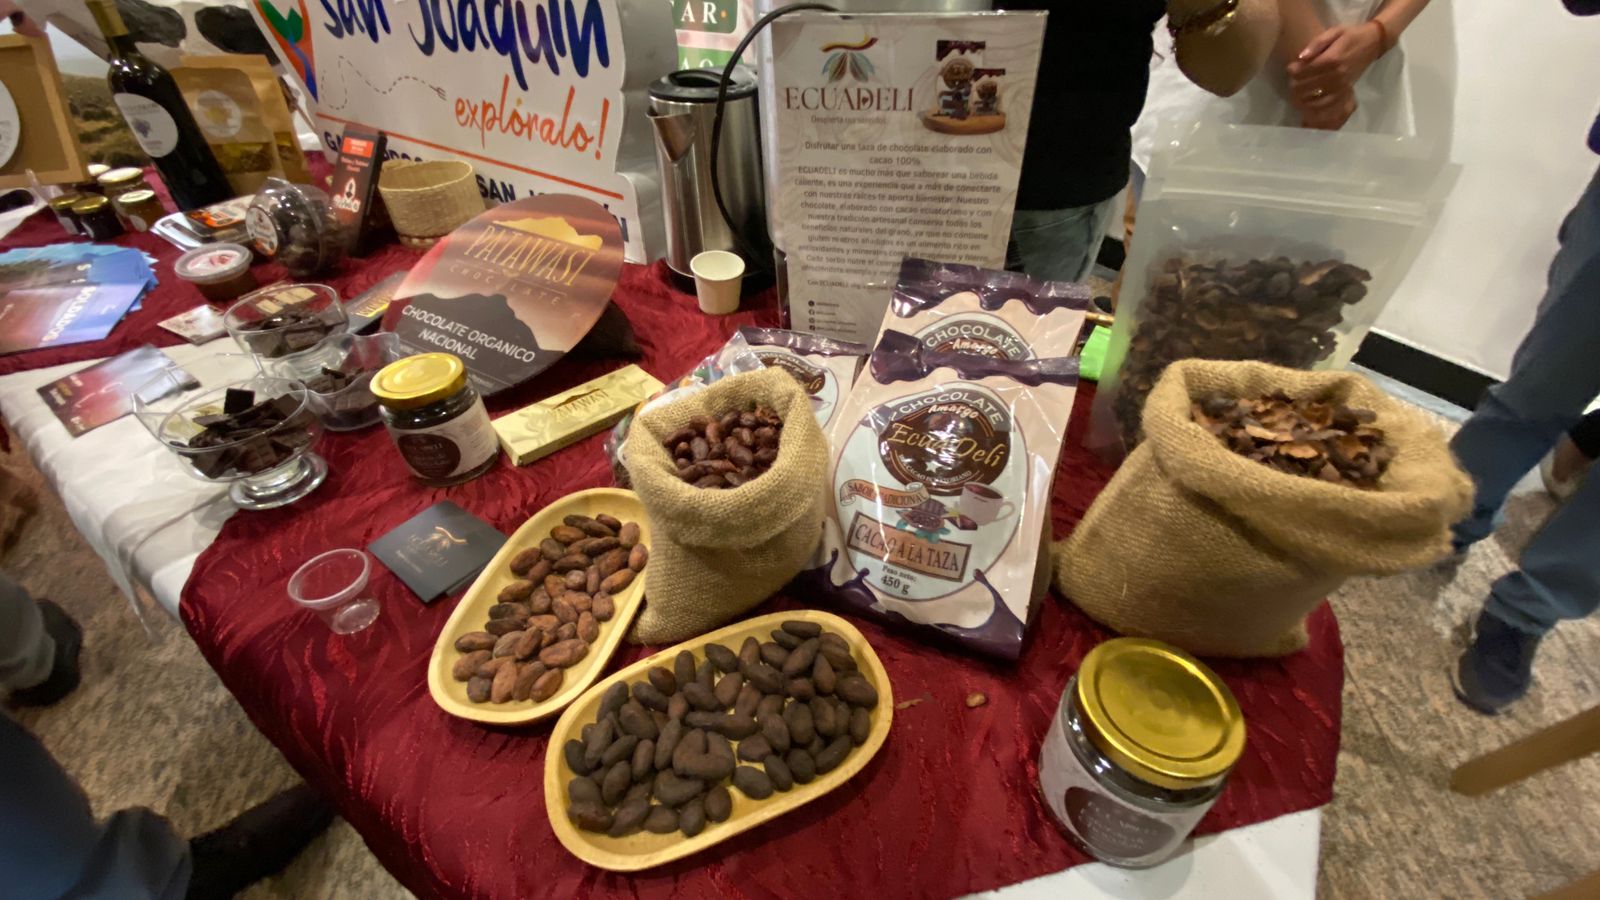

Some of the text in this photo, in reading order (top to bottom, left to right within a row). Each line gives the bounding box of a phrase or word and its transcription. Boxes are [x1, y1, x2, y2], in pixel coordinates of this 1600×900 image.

[785, 87, 914, 111] ECUADELI
[455, 73, 610, 160] explóralo!
[805, 141, 992, 154] Disfrutar una taza de chocolate elaborado con
[798, 166, 836, 175] ECUADELI
[849, 168, 876, 177] mucho
[896, 170, 912, 179] que
[475, 174, 516, 203] SAN
[900, 183, 916, 192] que
[943, 183, 955, 192] de
[957, 196, 990, 205] Nuestro
[464, 225, 596, 286] PATAWASI
[402, 304, 469, 337] CHOCOLATE
[467, 329, 536, 363] ORGANICO
[418, 327, 478, 360] NACIONAL
[926, 323, 1021, 357] CHOCOLATE
[900, 391, 1004, 425] CHOCOLATE
[928, 404, 979, 419] Amargo
[854, 523, 959, 572] CACAO A LA TAZA
[881, 575, 910, 595] 450 g
